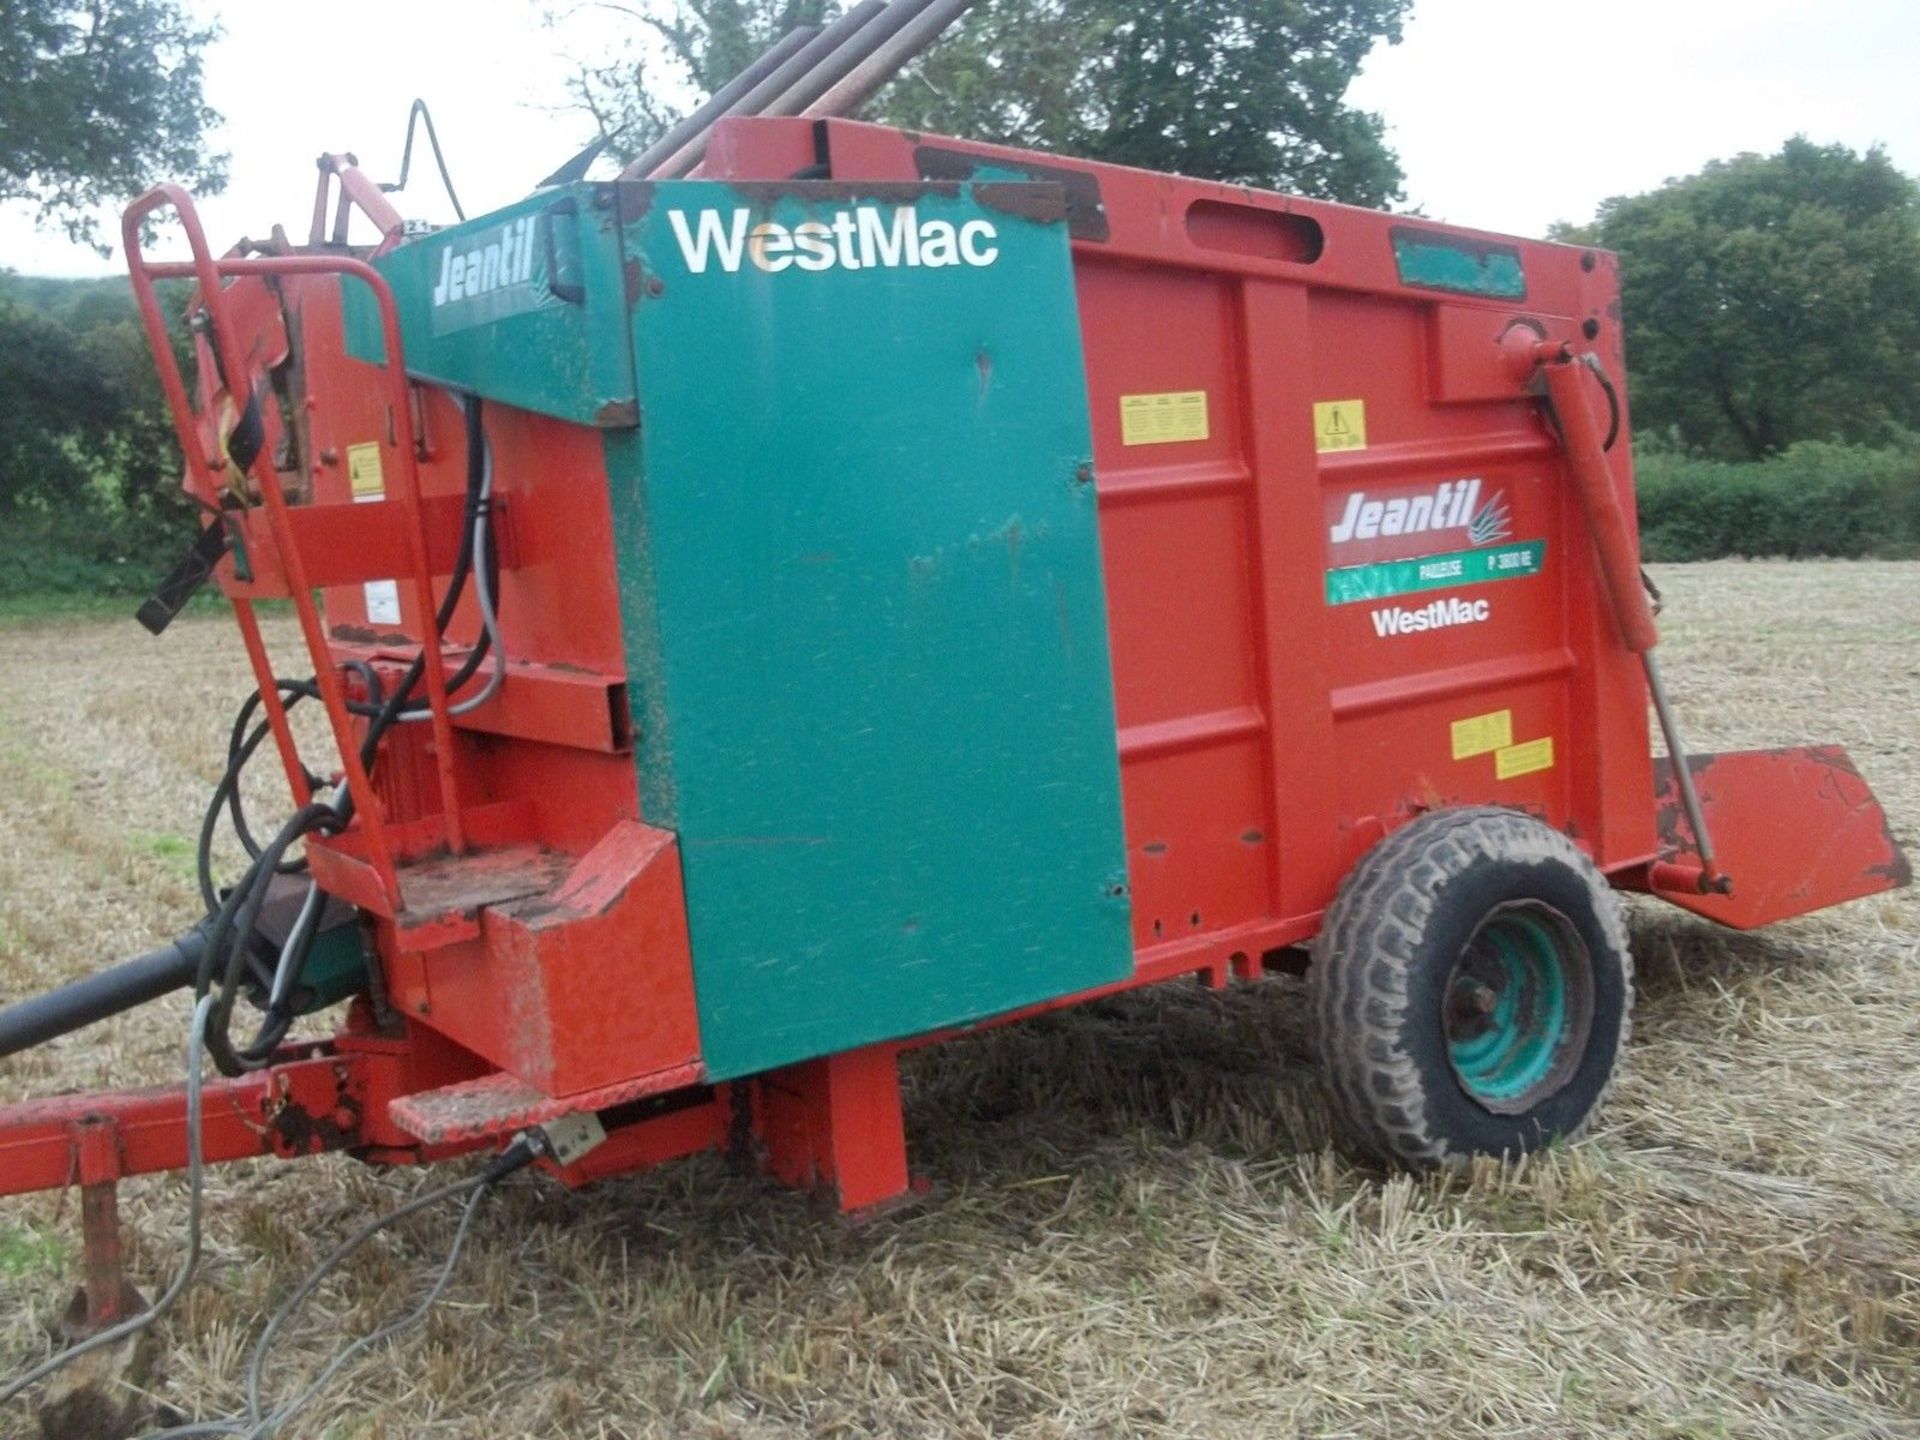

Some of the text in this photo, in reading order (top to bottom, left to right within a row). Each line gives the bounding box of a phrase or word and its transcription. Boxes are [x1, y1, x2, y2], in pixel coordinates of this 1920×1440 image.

[434, 215, 536, 307] Jeantil
[667, 205, 999, 274] WestMac
[1329, 479, 1482, 543] Jeantil
[1371, 598, 1490, 637] WestMac
